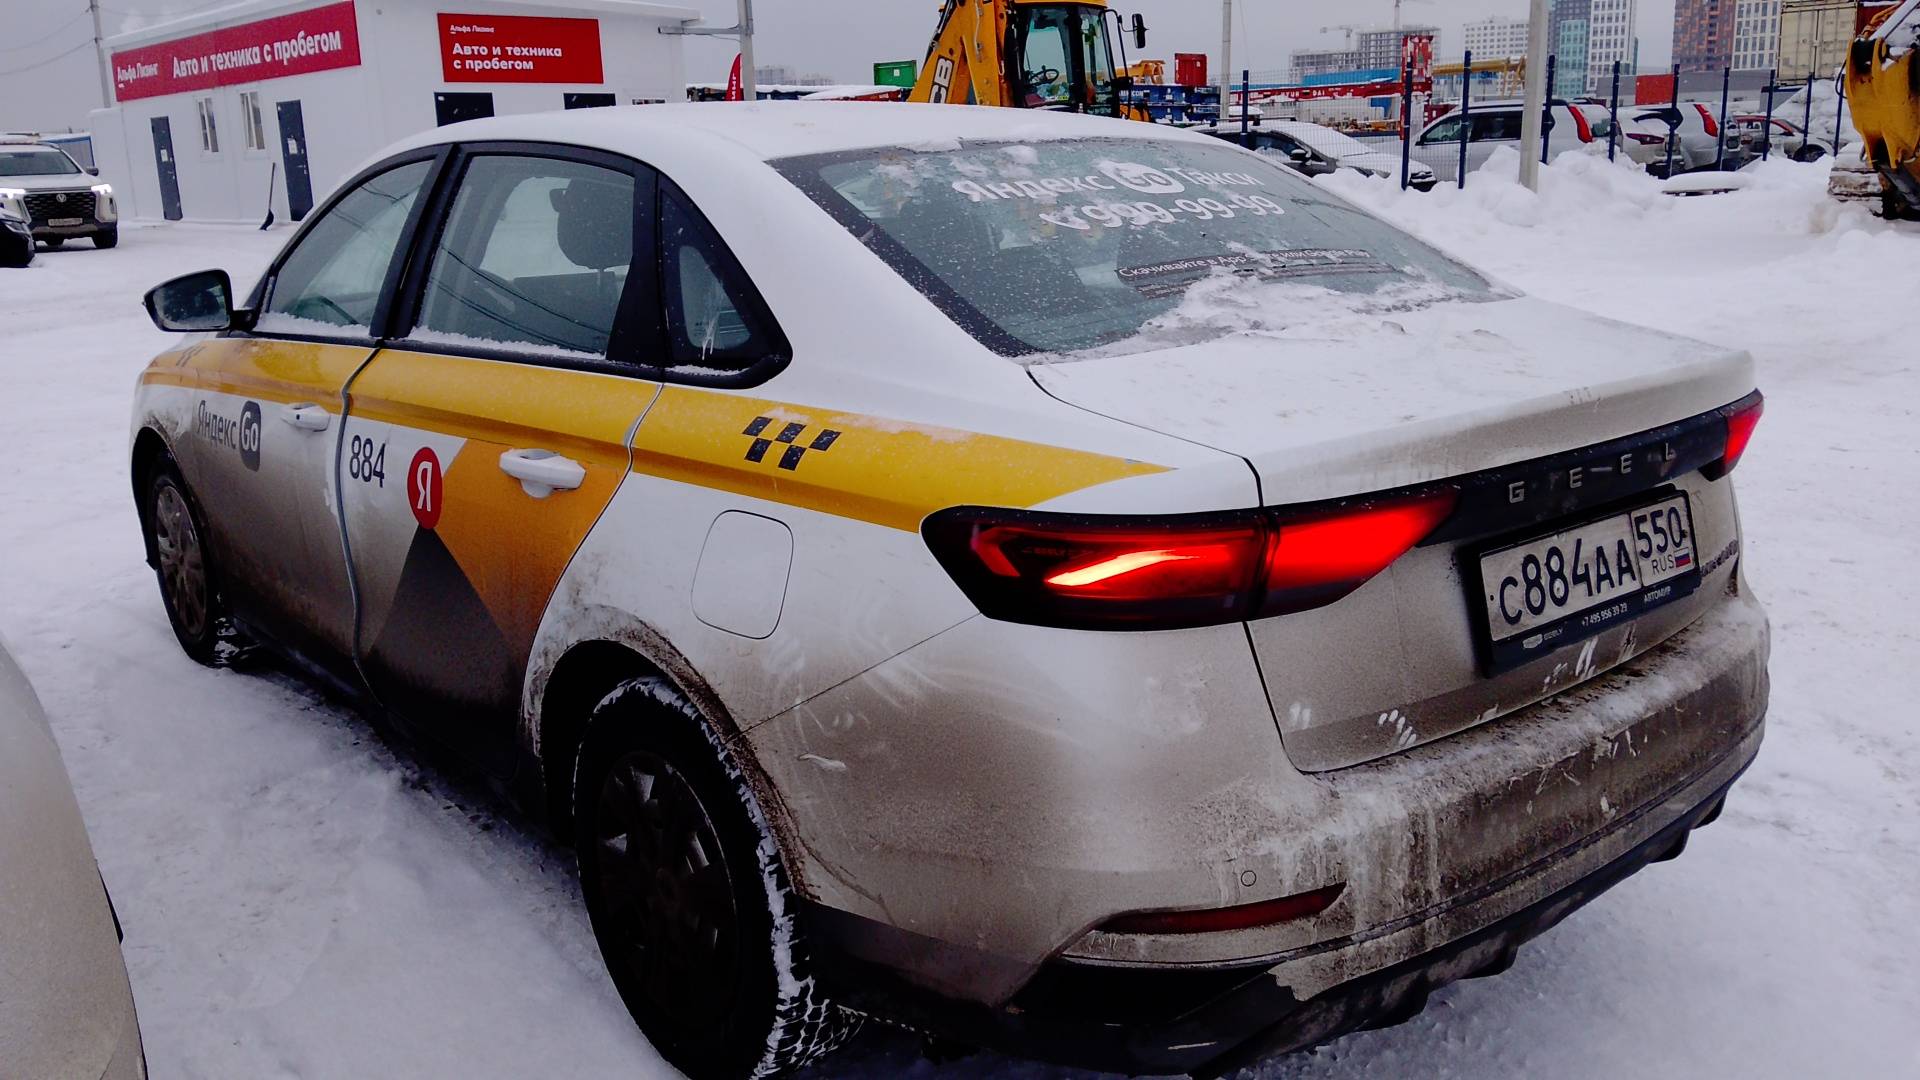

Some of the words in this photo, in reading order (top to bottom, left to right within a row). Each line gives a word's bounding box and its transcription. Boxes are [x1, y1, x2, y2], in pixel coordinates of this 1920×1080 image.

[172, 56, 199, 79] Авто
[200, 57, 209, 72] и
[210, 46, 261, 71] техника
[263, 46, 272, 62] с
[273, 30, 342, 65] пробегом
[453, 43, 488, 56] Авто
[492, 46, 502, 55] и
[505, 46, 563, 57] техника
[453, 60, 462, 69] с
[465, 58, 534, 72] пробегом
[952, 173, 1115, 202] Яндекс
[1164, 167, 1266, 187] Такси
[1082, 195, 1286, 228] 999-99-99
[1119, 259, 1207, 277] Скачивайте
[197, 400, 237, 449] Яндекс
[241, 411, 258, 452] Go
[350, 435, 386, 488] 884
[416, 461, 433, 512] Я
[1499, 538, 1637, 625] С884АА
[1634, 506, 1684, 559] 550
[1652, 556, 1675, 576] RUS
